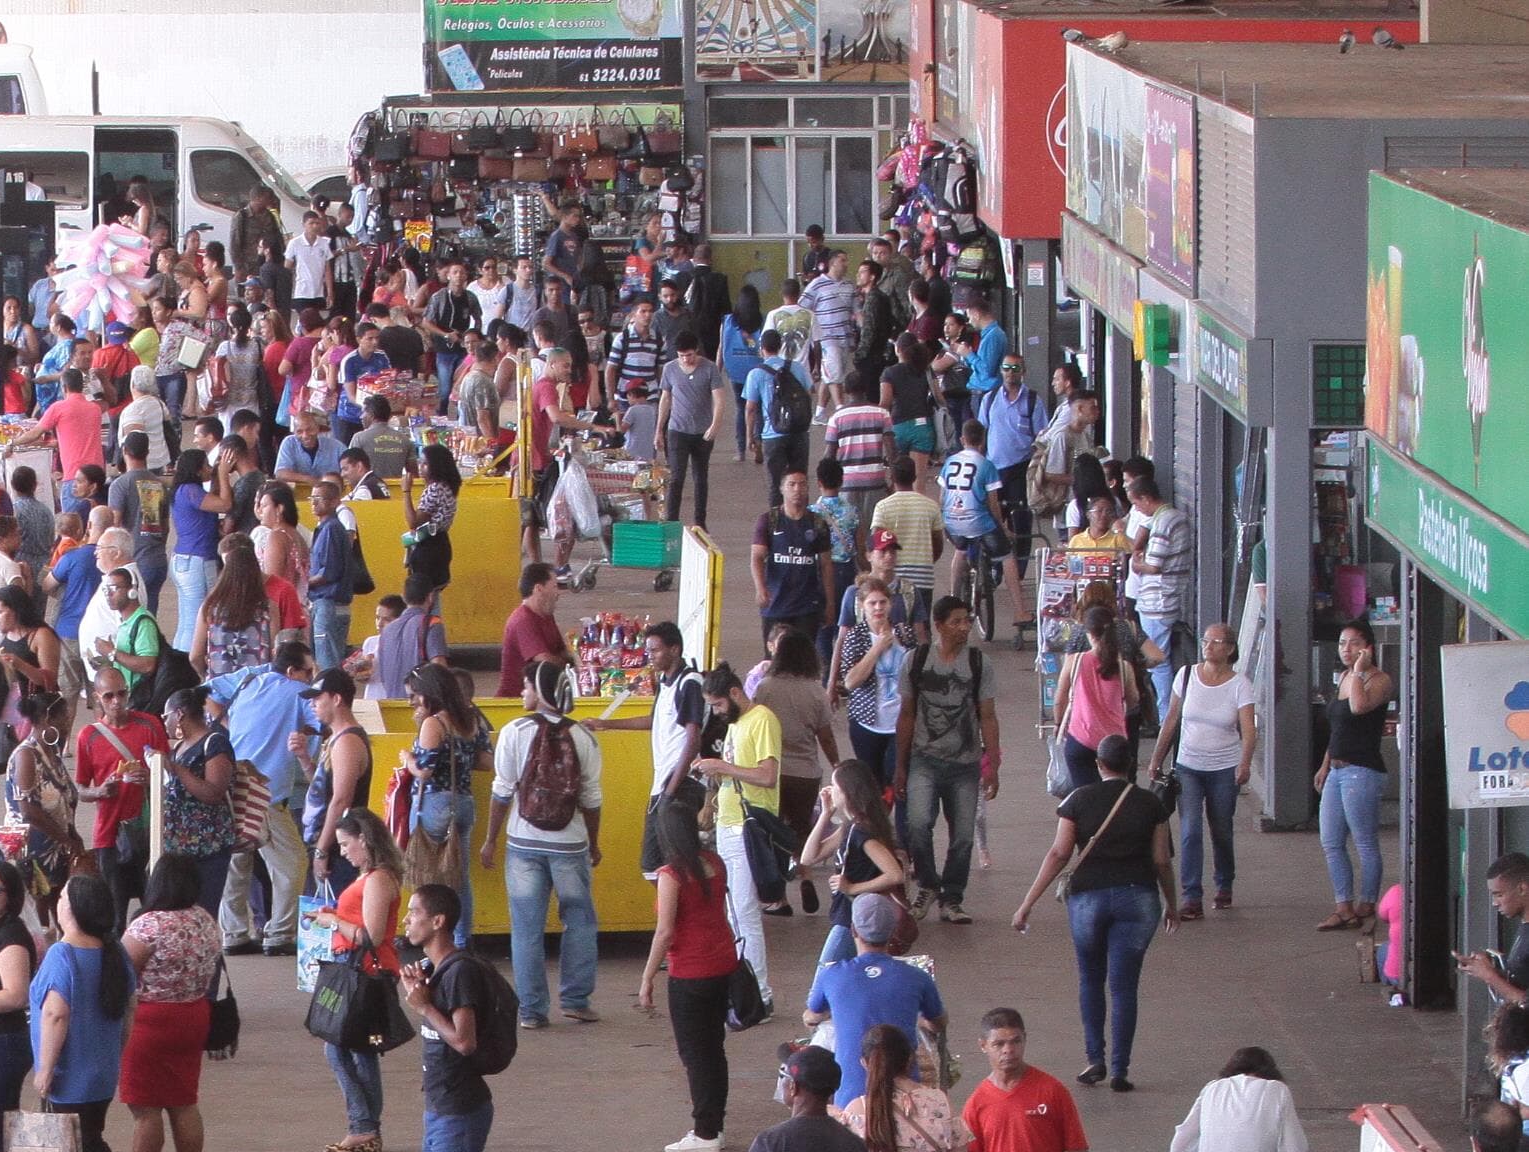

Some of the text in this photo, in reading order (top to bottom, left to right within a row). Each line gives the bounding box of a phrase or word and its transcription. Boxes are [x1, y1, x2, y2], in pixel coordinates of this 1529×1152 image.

[490, 45, 659, 61] Assistência Técnica de Celulares
[592, 67, 661, 82] 3224.0301
[5, 171, 24, 183] A 16
[946, 461, 977, 491] 23
[1418, 488, 1457, 573] Pastelaria
